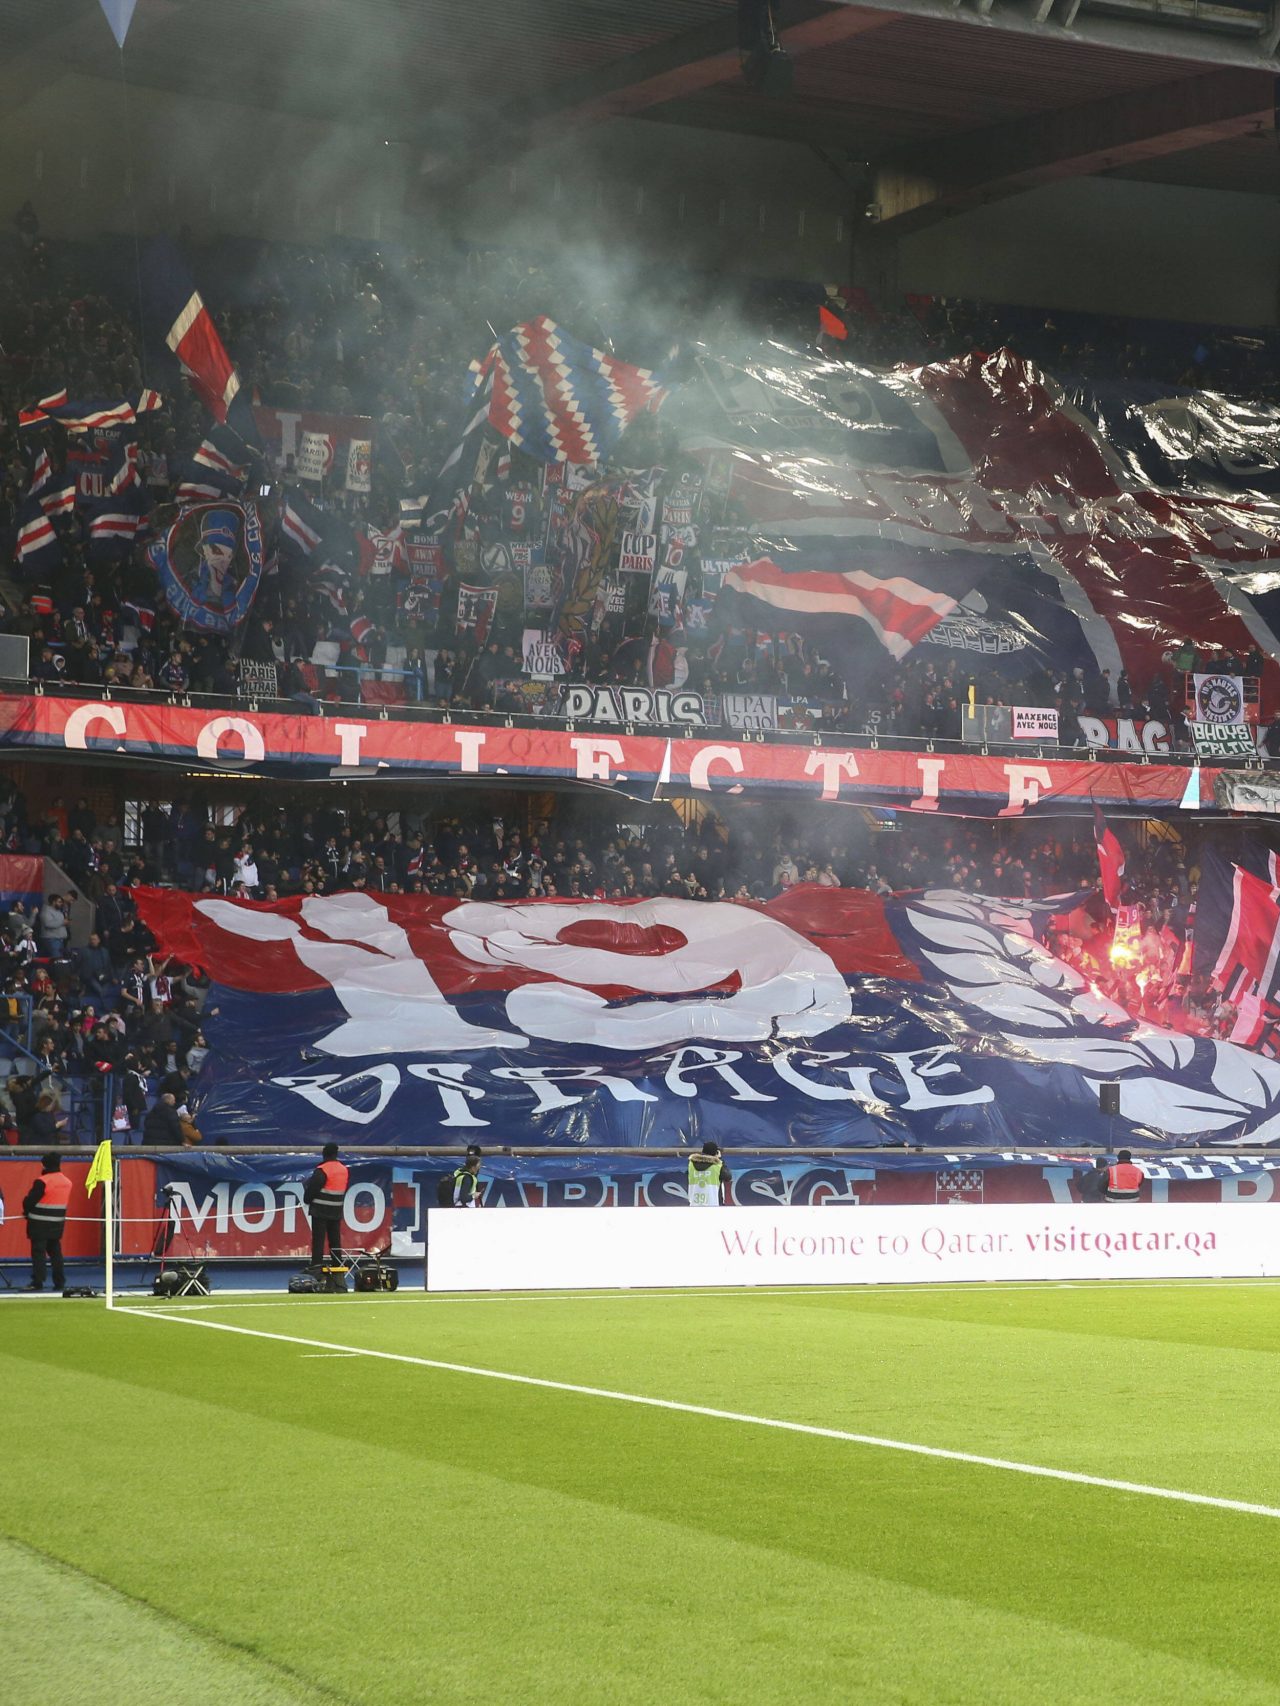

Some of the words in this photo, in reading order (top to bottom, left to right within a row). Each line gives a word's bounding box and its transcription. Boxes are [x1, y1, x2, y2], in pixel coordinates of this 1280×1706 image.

[505, 491, 532, 502] WEAH
[511, 505, 525, 526] 9
[414, 535, 439, 544] HOME
[624, 533, 655, 555] CUP
[621, 555, 654, 570] PARIS
[525, 656, 561, 673] NOUS
[242, 667, 275, 679] PARIS
[558, 684, 707, 725] PARIS
[732, 695, 767, 714] LPA
[791, 695, 808, 705] LPA
[731, 714, 773, 729] 2010
[1017, 712, 1057, 722] MAXENCE
[1016, 721, 1035, 730] AVEC
[1038, 722, 1058, 731] NOUS
[1193, 722, 1250, 741] BHOYS
[1196, 740, 1257, 756] CELTIC
[721, 1226, 866, 1258] Welcome
[877, 1232, 909, 1256] to
[922, 1226, 1014, 1261] Qatar.
[1026, 1228, 1218, 1258] visitqatar.qa
